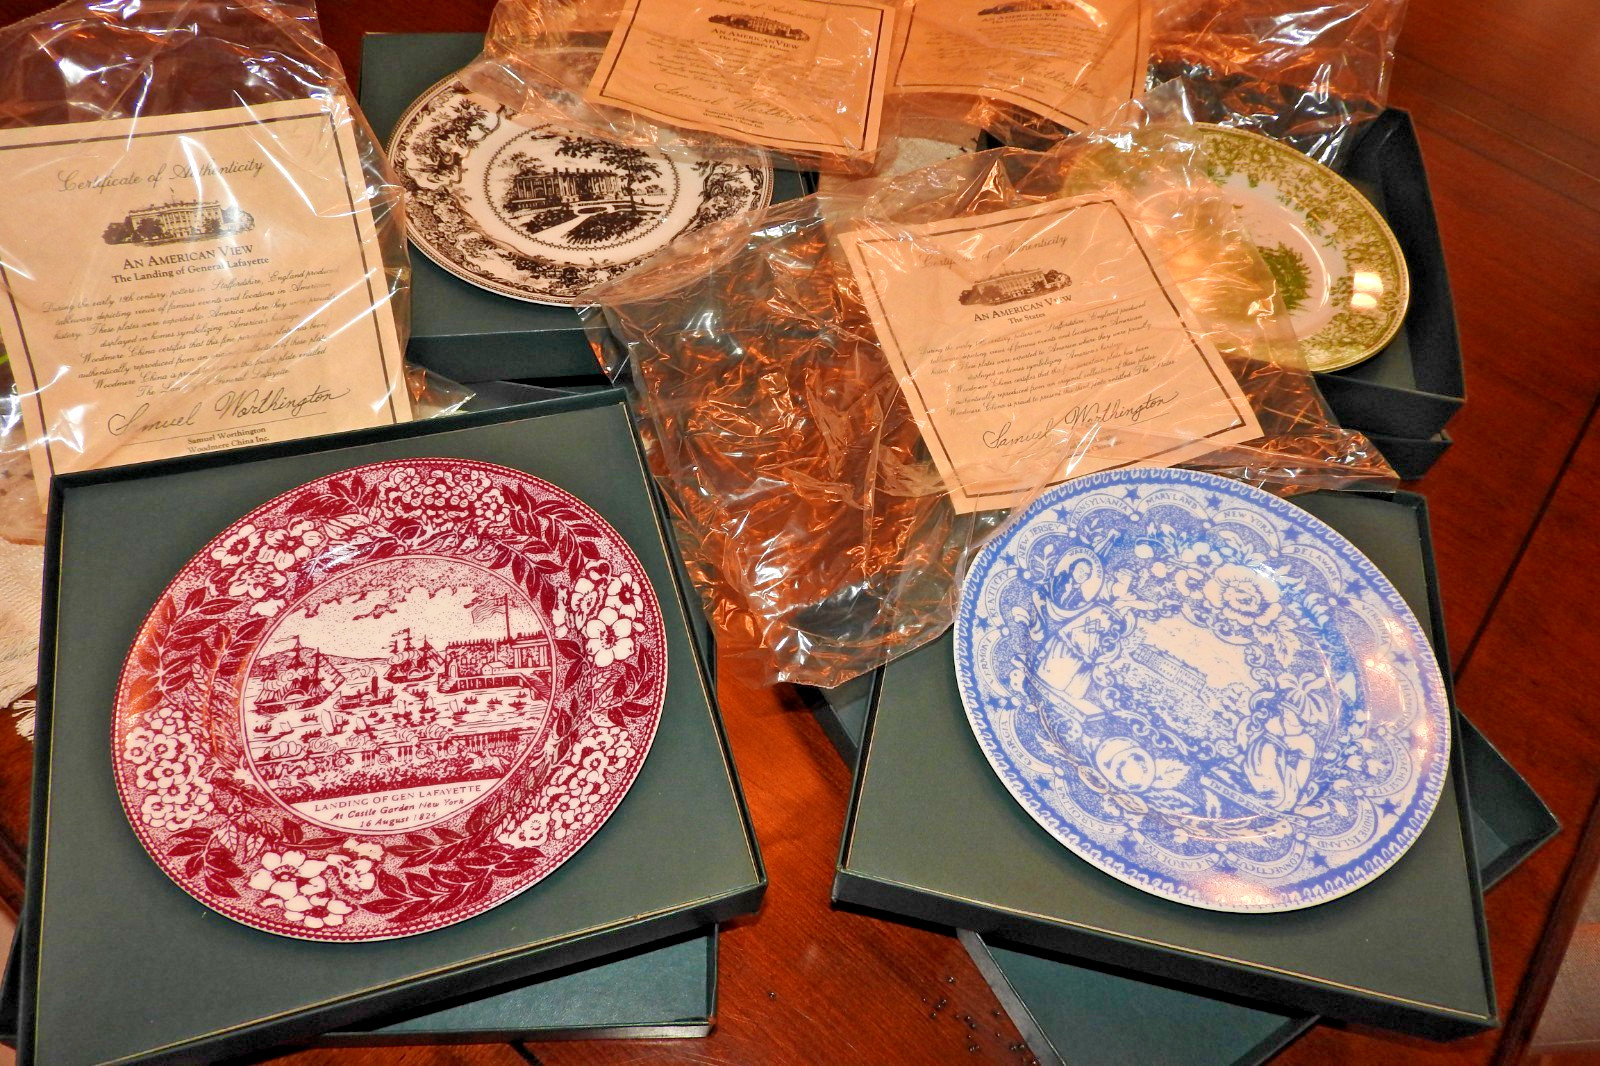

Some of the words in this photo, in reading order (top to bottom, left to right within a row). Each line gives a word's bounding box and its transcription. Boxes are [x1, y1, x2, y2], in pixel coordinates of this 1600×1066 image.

[728, 30, 774, 43] AMERICAN
[775, 39, 799, 49] VIEW
[147, 163, 167, 188] of
[123, 258, 144, 270] AN
[147, 249, 216, 267] AMERICAN
[217, 245, 253, 257] VIEW
[112, 271, 132, 284] The
[134, 269, 174, 282] Landing
[176, 266, 186, 275] of
[188, 262, 225, 274] General
[227, 257, 270, 270] Lafayette
[268, 271, 304, 284] England
[224, 294, 239, 302] and
[242, 290, 275, 300] locations
[88, 321, 114, 336] These
[116, 321, 139, 332] plates
[208, 306, 245, 317] America
[974, 313, 990, 322] AN
[992, 301, 1043, 319] AMERICAN
[1008, 316, 1024, 325] The
[1024, 312, 1046, 322] States
[151, 331, 175, 341] homes
[80, 352, 124, 364] Woodmere
[108, 400, 203, 436] Smuel
[214, 384, 351, 420] Worthington
[187, 434, 215, 444] Samuel
[217, 427, 266, 439] Worthington
[982, 417, 1055, 450] Samuel
[187, 443, 229, 453] Woodmere
[1072, 497, 1129, 526] PENNSYLVANIA
[1145, 492, 1199, 510] MARYLAND
[1223, 510, 1247, 519] NEW
[1250, 514, 1274, 537] YORK
[1019, 536, 1030, 560] NEW
[1029, 523, 1062, 538] JERSEY
[1294, 546, 1341, 584] DELAWARE
[987, 570, 1010, 618] KENTUCKY
[1362, 604, 1390, 646] VIRGINIA
[1000, 720, 1032, 766] GEORGIA
[314, 798, 369, 812] LANDING
[372, 795, 388, 804] OF
[391, 792, 415, 802] GEN
[419, 784, 482, 798] LAFAYETTE
[1056, 786, 1106, 833] CAROLINA
[330, 813, 343, 821] At
[347, 808, 377, 819] Castle
[380, 804, 415, 814] Garden
[375, 816, 409, 826] August
[413, 812, 437, 821] 1824
[1360, 809, 1374, 838] RHODE
[1317, 836, 1362, 848] ISLAND
[1234, 852, 1301, 876] CONNECTICUT
